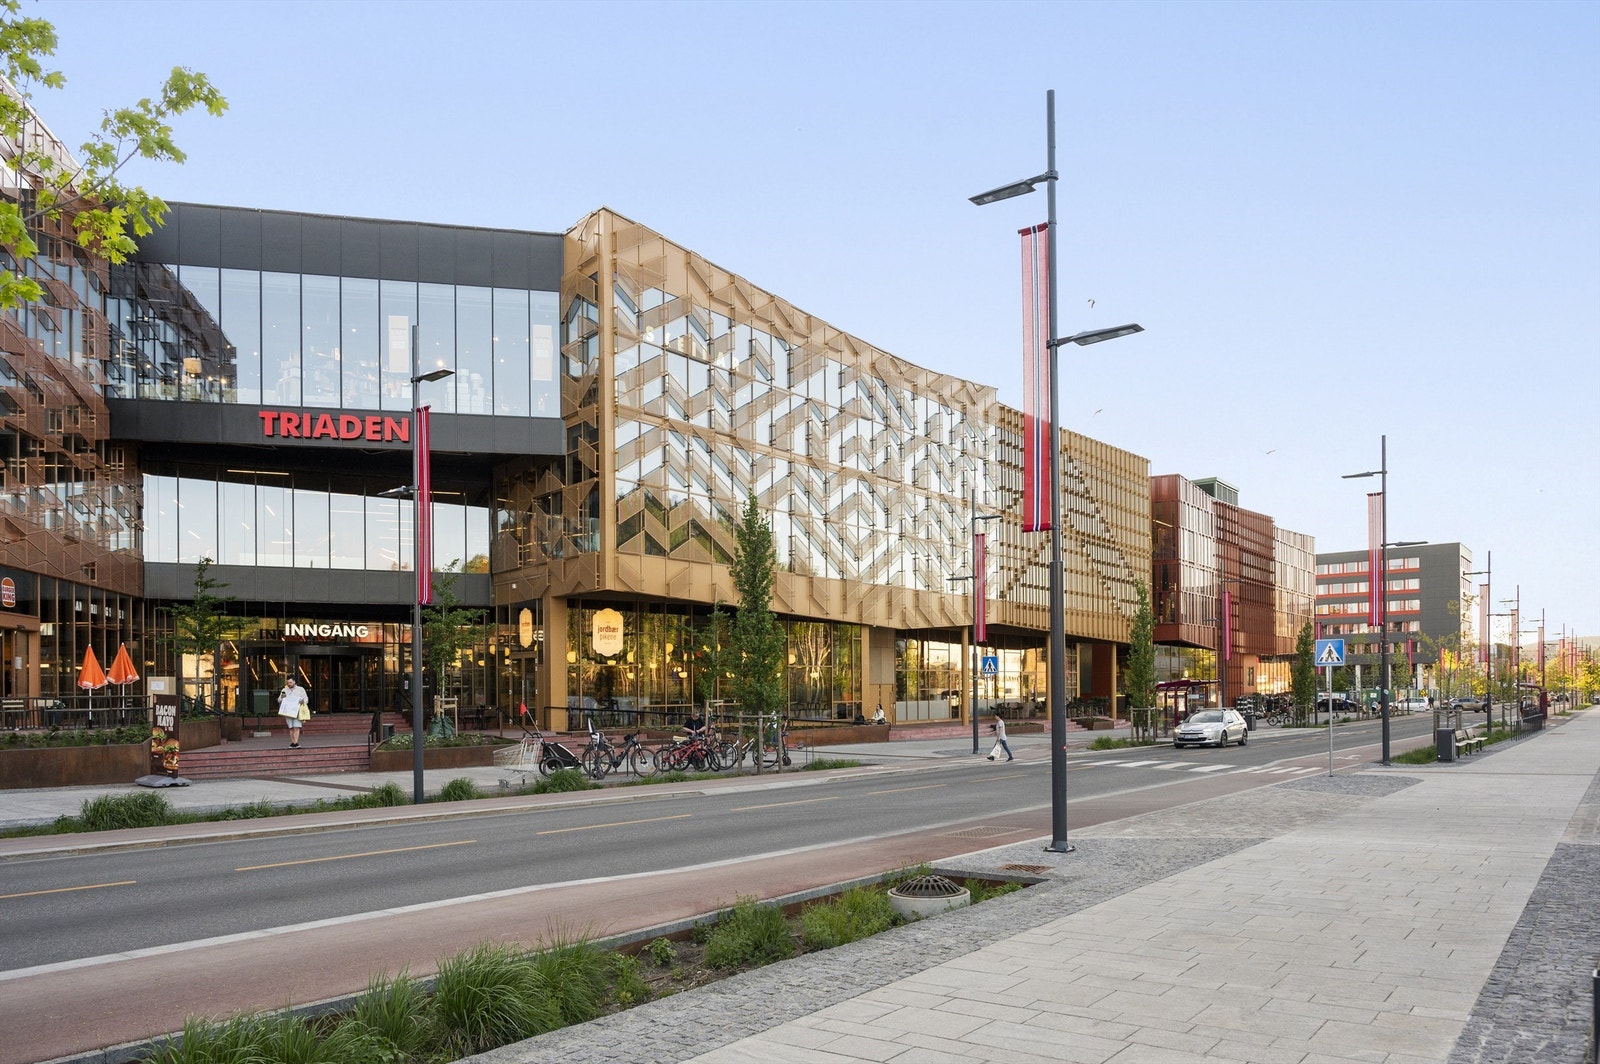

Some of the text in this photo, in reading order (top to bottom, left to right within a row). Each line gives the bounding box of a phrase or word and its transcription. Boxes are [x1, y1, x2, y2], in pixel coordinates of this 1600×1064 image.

[258, 410, 410, 443] TRIADEN
[284, 623, 369, 638] INNGANG
[155, 704, 177, 717] BACON
[156, 715, 174, 727] MAYO
